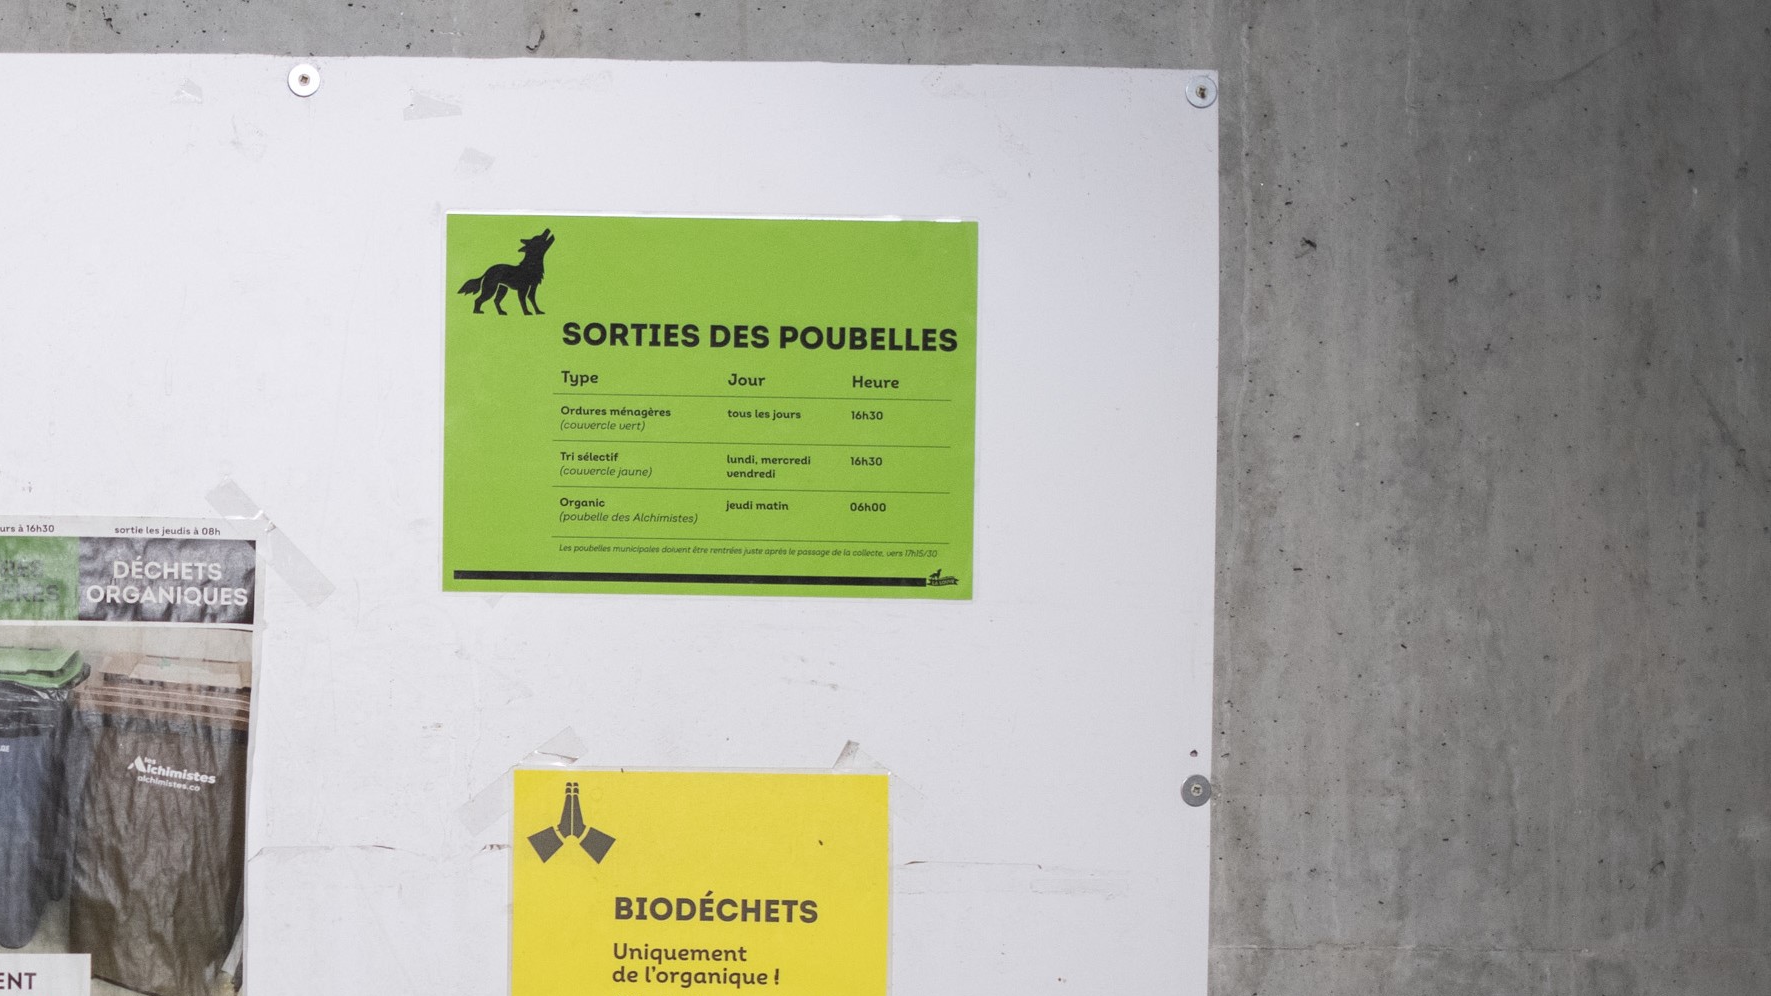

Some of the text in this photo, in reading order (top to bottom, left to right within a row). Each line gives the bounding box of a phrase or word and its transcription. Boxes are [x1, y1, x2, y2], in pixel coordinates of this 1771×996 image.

[563, 322, 957, 352] SORTIES DES POUBELLES
[561, 371, 598, 386] Type
[728, 374, 765, 386] Jour
[853, 376, 899, 388] Heure
[560, 405, 671, 420] Ordures ménagères
[728, 410, 801, 421] tous les jours
[852, 411, 883, 420] 16h30
[561, 419, 645, 432] (couvercle vert)
[560, 452, 618, 461] Tri sélectif
[727, 455, 810, 465] lundi, mercredi
[851, 457, 882, 466] 16h30
[560, 466, 652, 478] (couvercle jaune)
[727, 469, 775, 478] vendredi
[560, 498, 604, 509] Organic
[726, 501, 788, 511] jeudi matin
[850, 503, 886, 512] 06h00
[560, 511, 698, 524] (poubelle des Alchimistes)
[18, 524, 24, 532] à
[26, 524, 55, 533] 16h30
[114, 526, 221, 537] sortie les jeudis à 08h
[574, 545, 611, 553] poubelles
[613, 545, 659, 554] municipales
[743, 548, 763, 556] juste
[765, 548, 787, 556] après
[114, 555, 223, 581] DÉCHETS
[86, 583, 248, 608] ORGANIQUES
[615, 891, 817, 923] BIODÉCHETS
[614, 943, 747, 964] Uniquement
[613, 966, 638, 982] de
[646, 966, 767, 989] l'organique
